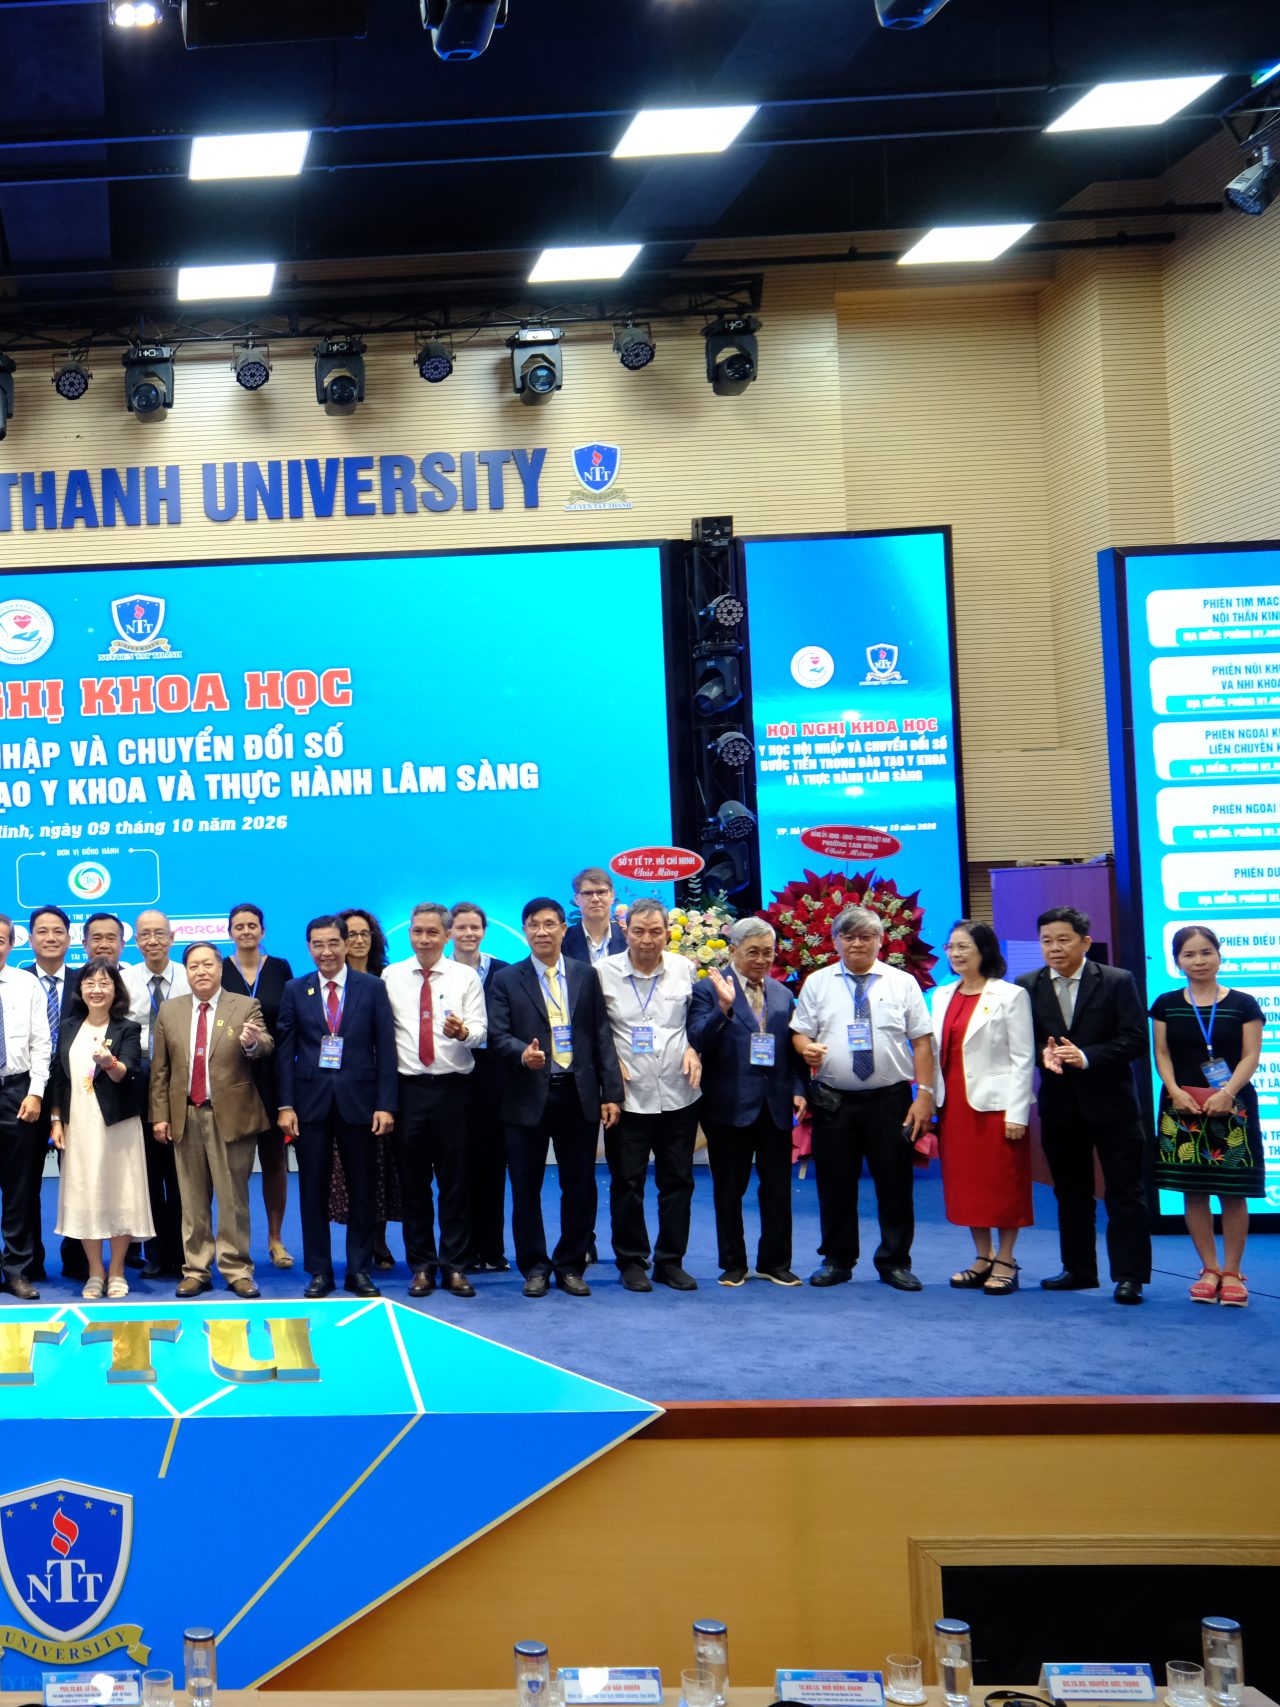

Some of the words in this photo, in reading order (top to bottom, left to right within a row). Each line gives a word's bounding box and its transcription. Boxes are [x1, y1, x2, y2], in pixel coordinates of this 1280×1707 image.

[584, 467, 611, 481] NTT
[202, 448, 547, 522] UNIVERSITY
[1236, 598, 1253, 607] TIM
[126, 620, 153, 633] NTT
[80, 672, 230, 717] KHOA
[244, 668, 352, 715] HỌC
[1237, 680, 1253, 689] NHI
[767, 722, 797, 740] HỘI
[802, 722, 845, 738] NGHỊ
[851, 720, 898, 735] KHOA
[903, 718, 938, 735] HỌC
[70, 735, 108, 766] VÀ
[119, 725, 234, 766] CHUYỂN
[244, 723, 294, 761] ĐỔI
[303, 722, 345, 759] SỐ
[759, 745, 766, 756] Y
[847, 740, 862, 753] VÀ
[884, 756, 904, 769] TẠO
[907, 755, 915, 765] Y
[917, 754, 946, 765] KHOA
[42, 780, 59, 807] Y
[68, 776, 147, 805] KHOA
[158, 770, 196, 802] VÀ
[205, 770, 281, 805] THỰC
[291, 765, 373, 797] HÀNH
[381, 761, 447, 794] LÂM
[456, 759, 539, 791] SÀNG
[785, 773, 799, 785] VÀ
[866, 770, 889, 782] LÂM
[39, 822, 82, 840] ngày
[86, 820, 111, 836] 09
[115, 817, 166, 837] tháng
[171, 818, 193, 833] 10
[198, 816, 237, 832] năm
[242, 814, 288, 831] 2026
[619, 856, 628, 866] SỞ
[634, 855, 643, 865] TẾ
[656, 854, 664, 864] HỒ
[667, 855, 677, 864] CHÍ
[634, 868, 654, 877] Chúc
[26, 1558, 102, 1603] NTT
[5, 1630, 126, 1660] UNIVERSITY
